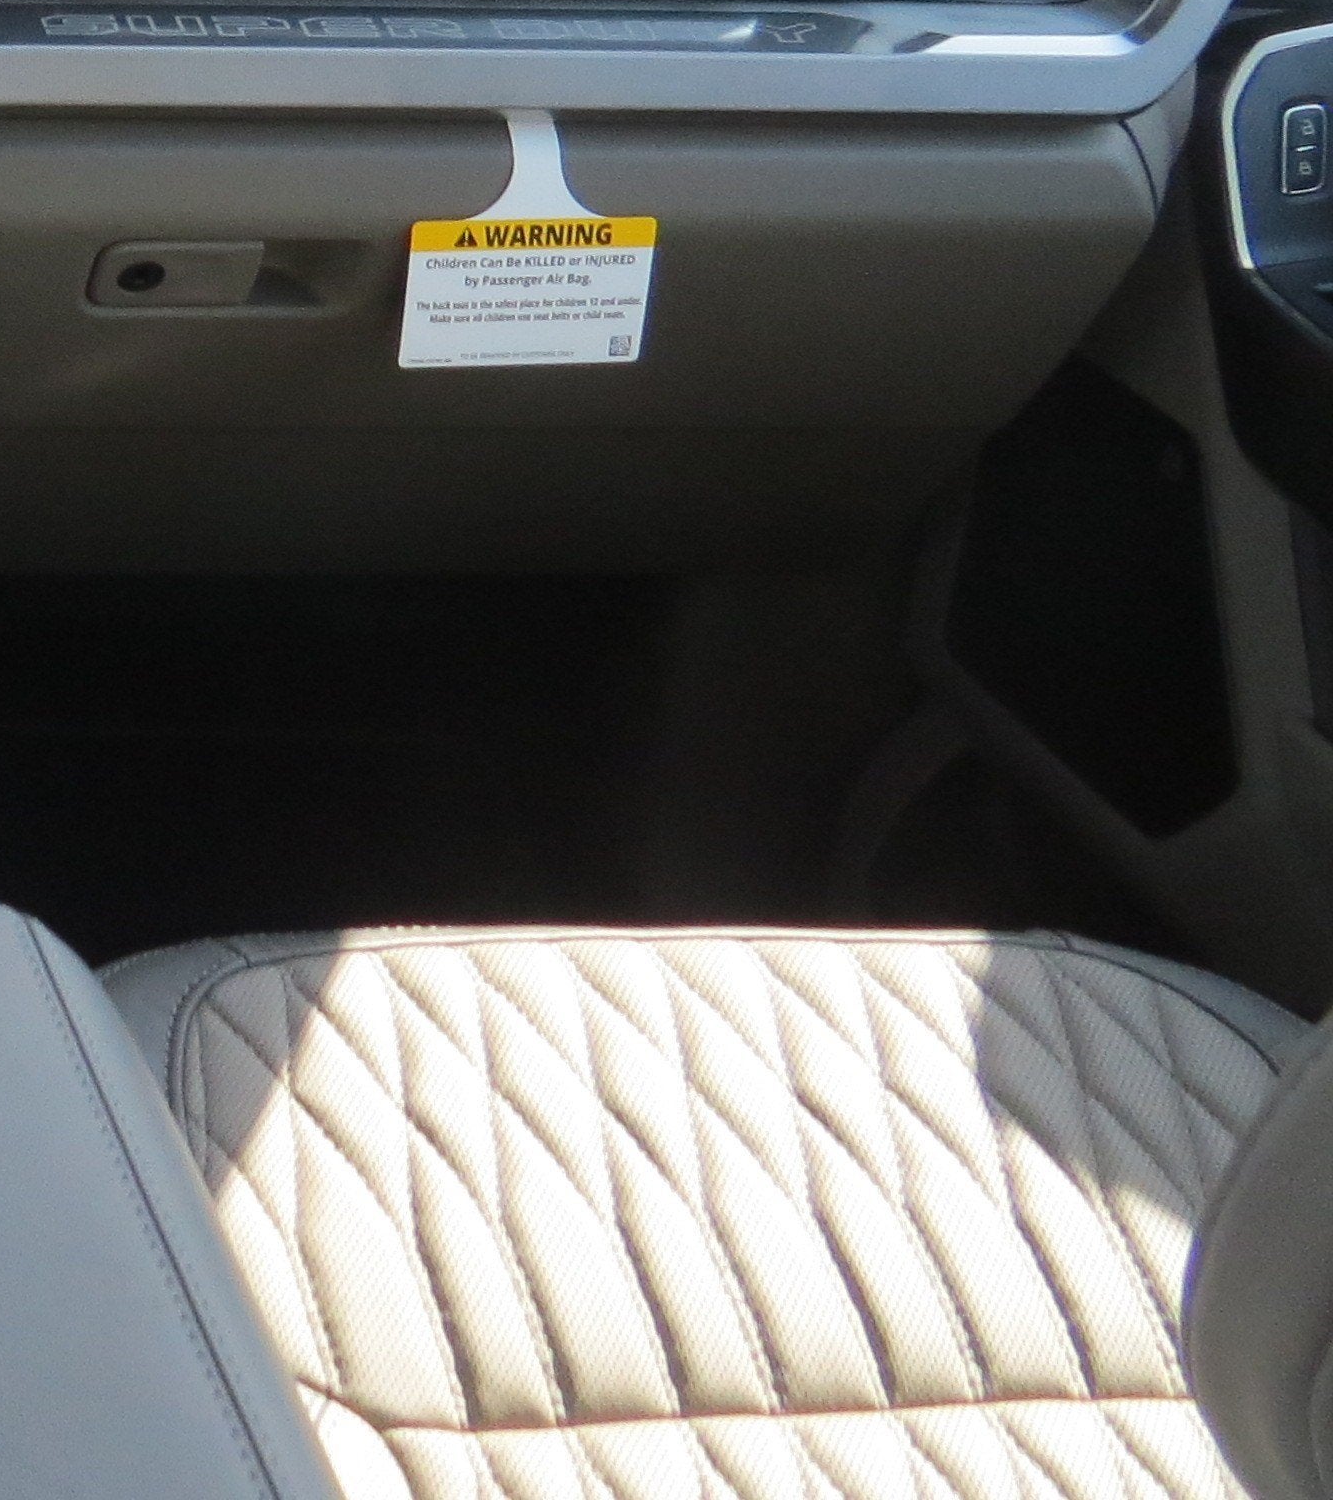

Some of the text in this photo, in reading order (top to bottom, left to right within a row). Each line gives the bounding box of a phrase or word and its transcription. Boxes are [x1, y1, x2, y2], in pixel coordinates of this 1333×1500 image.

[41, 14, 468, 40] SUPER
[484, 223, 613, 247] WARNING
[425, 254, 636, 270] Children Can Be KILLED or INJURED
[464, 272, 592, 287] by Passenger Air Bag.
